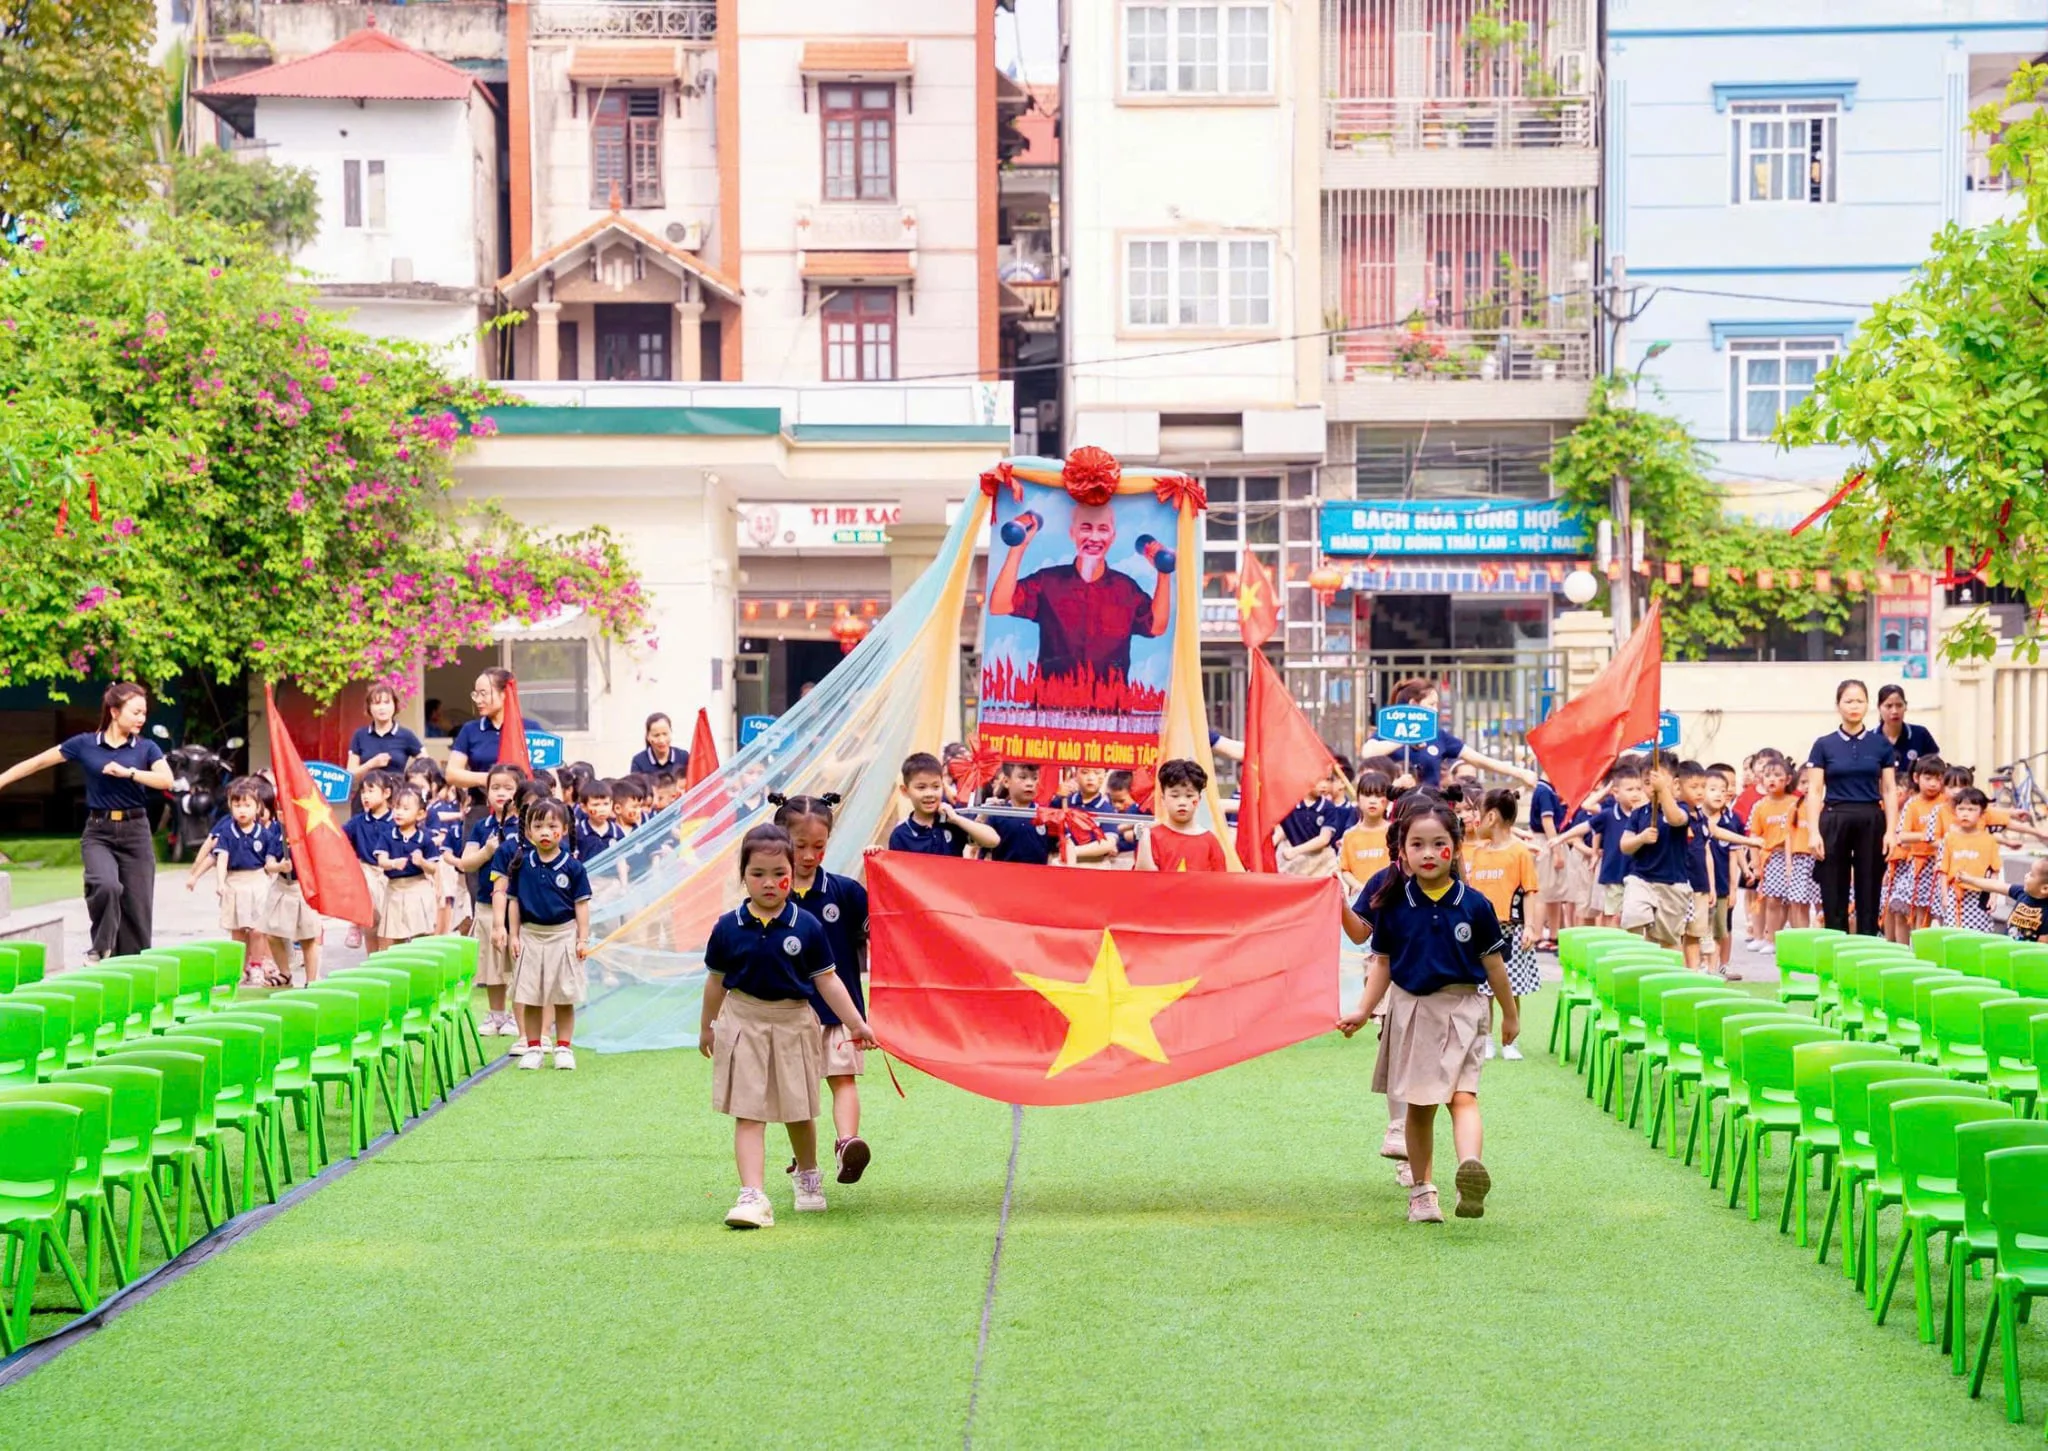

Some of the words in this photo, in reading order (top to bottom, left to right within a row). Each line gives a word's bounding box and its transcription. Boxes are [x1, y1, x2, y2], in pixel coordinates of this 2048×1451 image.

[1414, 505, 1458, 530] HÓA
[1479, 534, 1507, 550] LAN
[1519, 533, 1548, 553] VIỆT
[1386, 710, 1406, 720] LỚP
[1394, 722, 1421, 738] A2
[1006, 733, 1024, 757] TÔI
[1025, 735, 1056, 760] NGÀY
[1057, 737, 1081, 761] NÀO
[1084, 738, 1102, 763] TÔI
[1104, 740, 1135, 765] CŨNG
